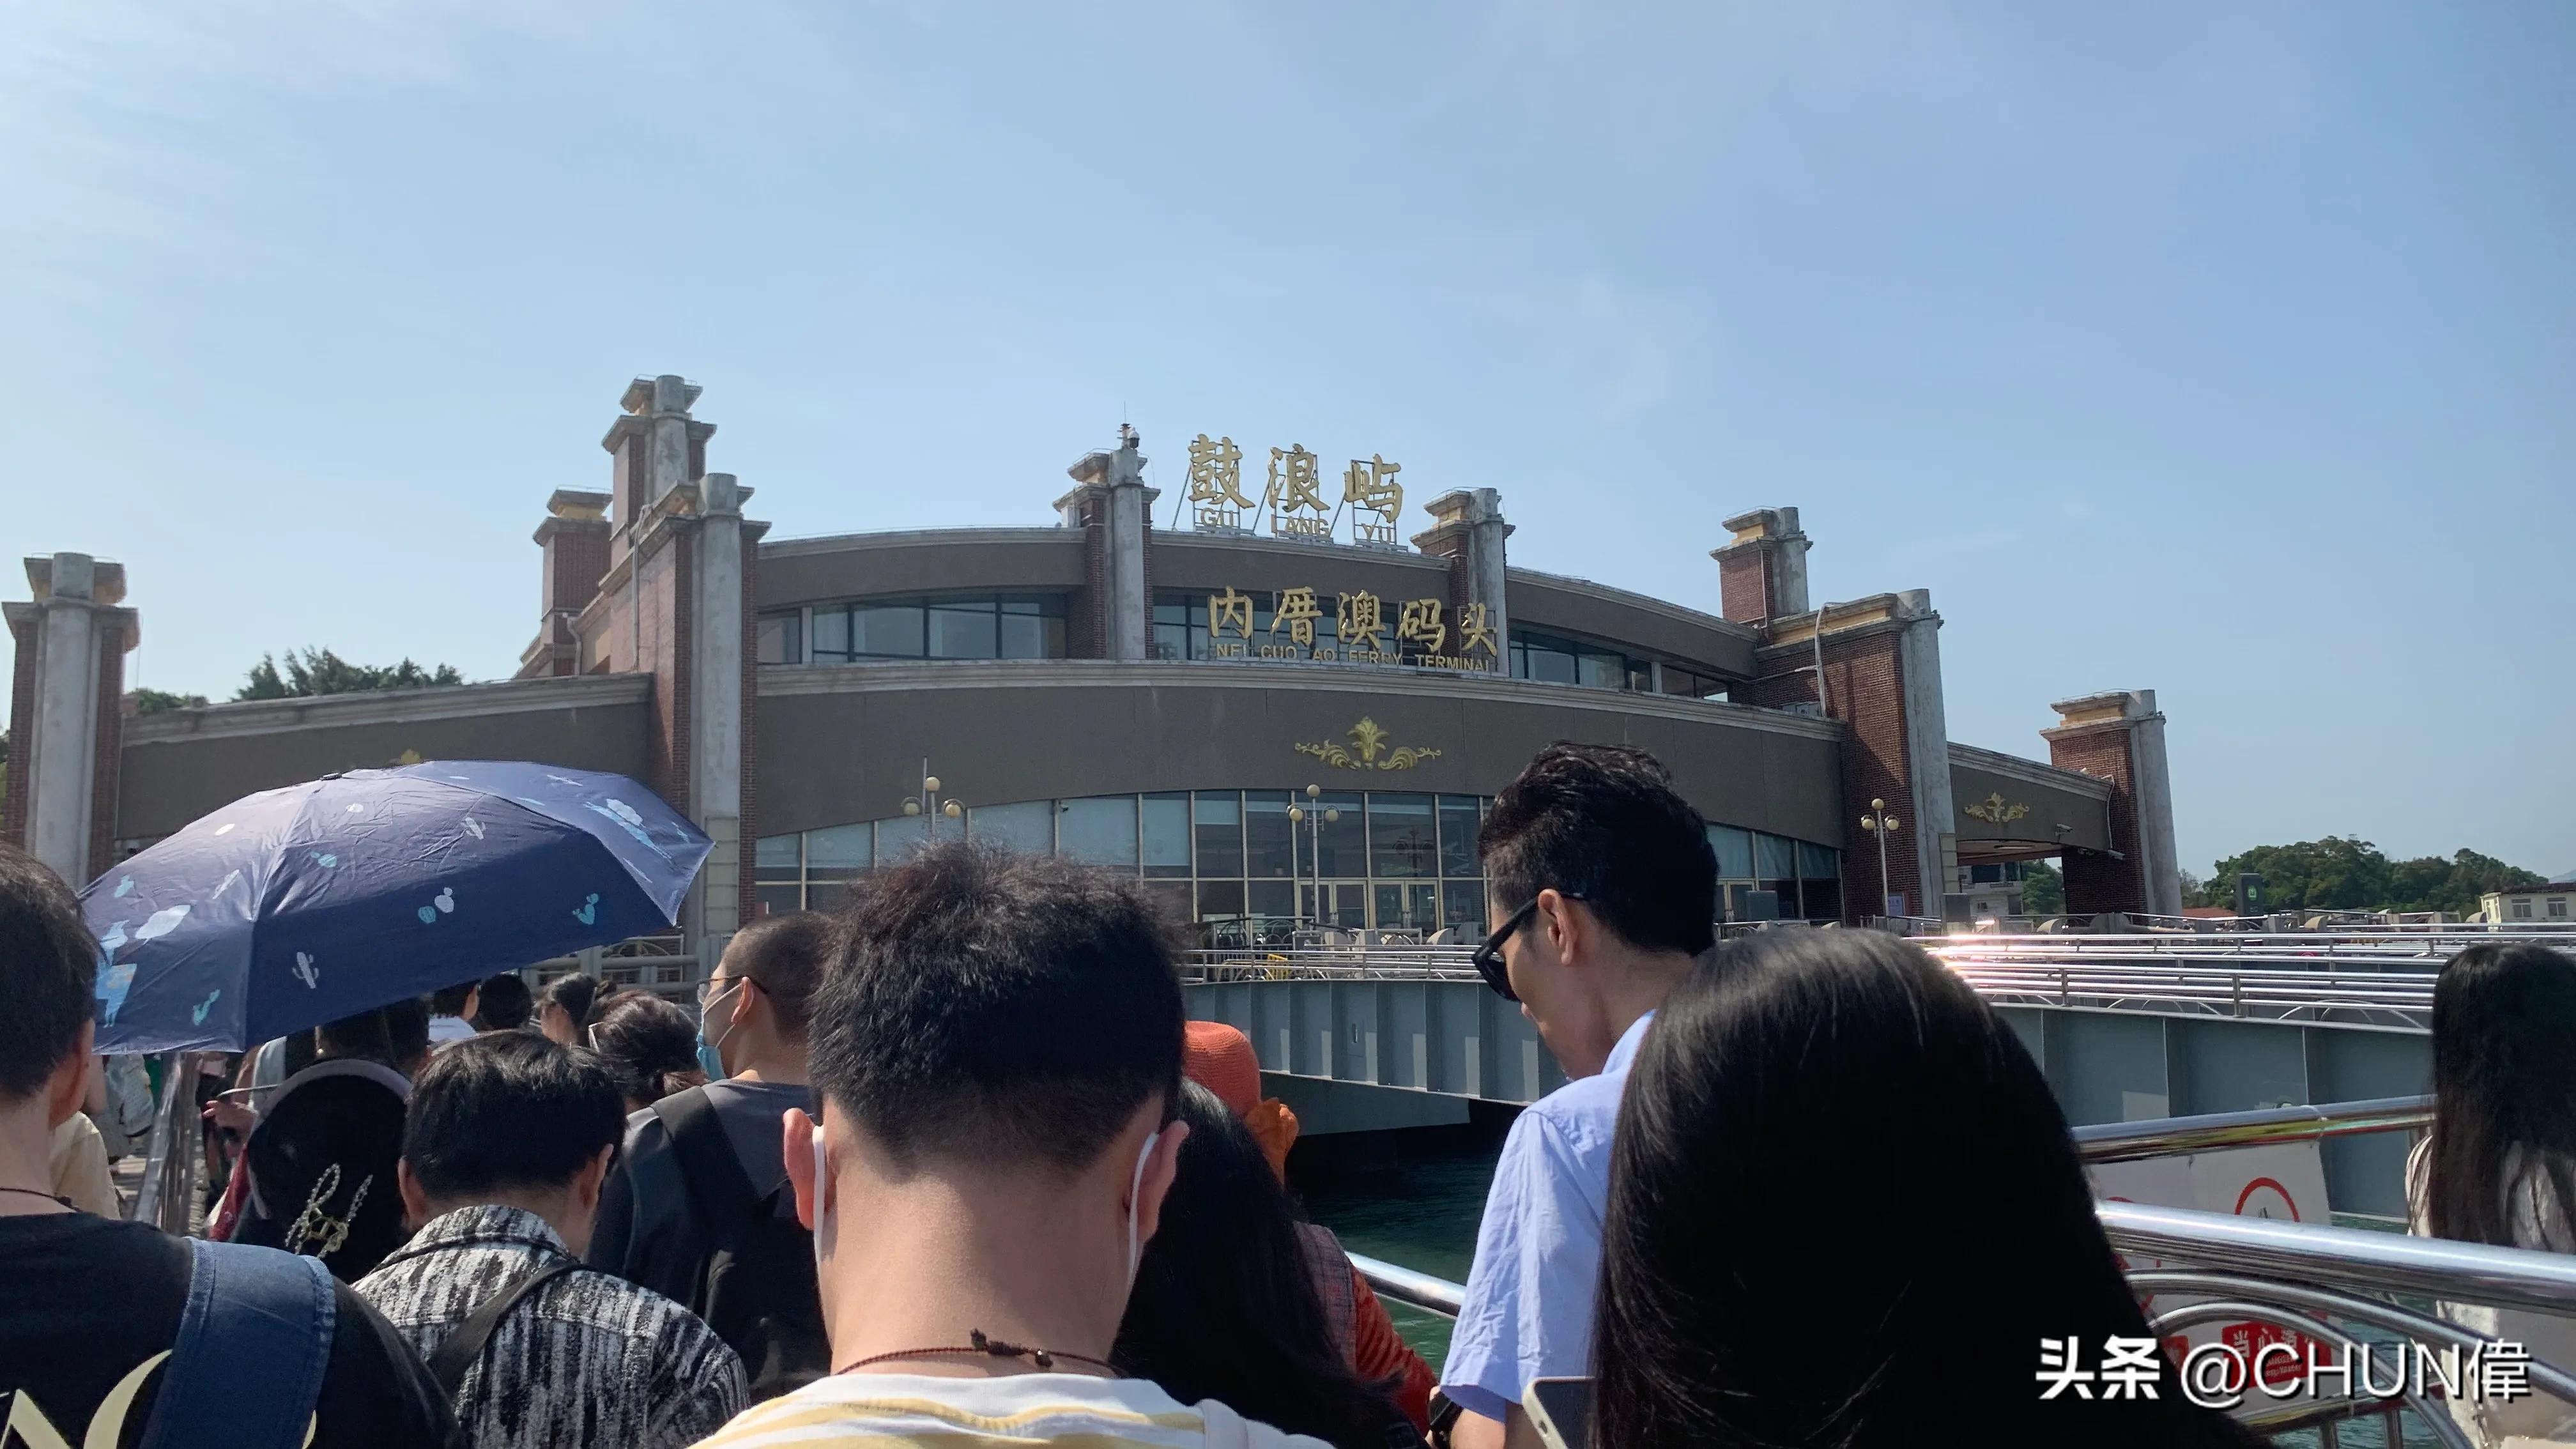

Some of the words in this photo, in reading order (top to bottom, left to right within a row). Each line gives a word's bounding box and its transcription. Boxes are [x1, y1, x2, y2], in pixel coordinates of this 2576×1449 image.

[1188, 434, 1404, 523] 鼓浪屿
[1200, 507, 1234, 528] GU
[1271, 514, 1330, 537] LANG
[1361, 523, 1392, 543] YU
[1209, 586, 1498, 657] 内厝澳码头
[1216, 643, 1246, 657] NEI
[1312, 648, 1335, 661] AO
[1349, 650, 1402, 665] FERRY
[1414, 654, 1489, 671] TERMINAL
